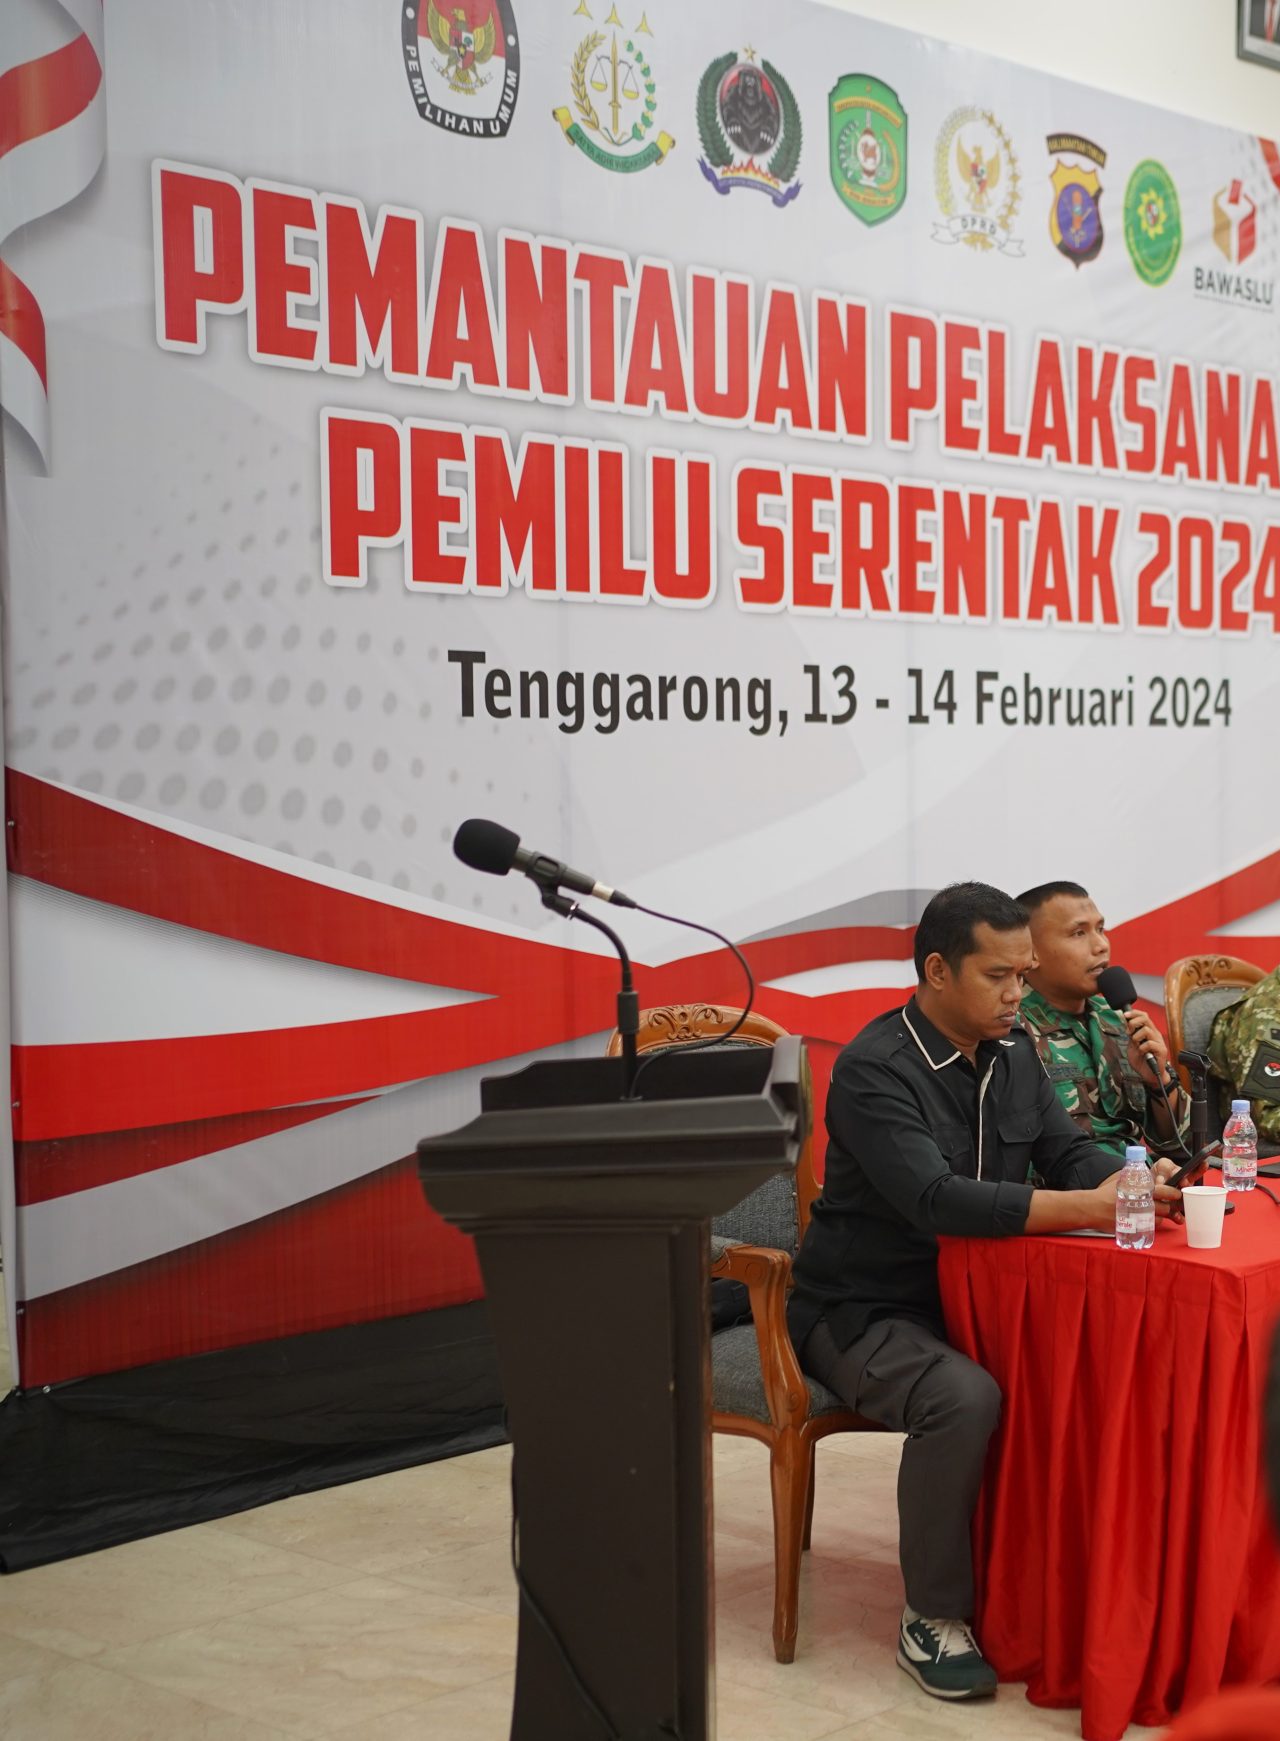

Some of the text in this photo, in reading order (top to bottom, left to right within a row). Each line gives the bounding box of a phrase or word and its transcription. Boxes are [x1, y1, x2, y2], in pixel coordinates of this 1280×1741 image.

[406, 45, 517, 134] PEMILIHAN UMUM
[961, 217, 996, 235] DPRD
[159, 168, 868, 437] PEMANTAUAN
[1194, 265, 1274, 306] BAWASLU
[326, 416, 712, 601] PEMILU
[736, 466, 1121, 626] SERENTAK
[447, 649, 1232, 738] Tenggarong, 13 - 14 Februari 2024
